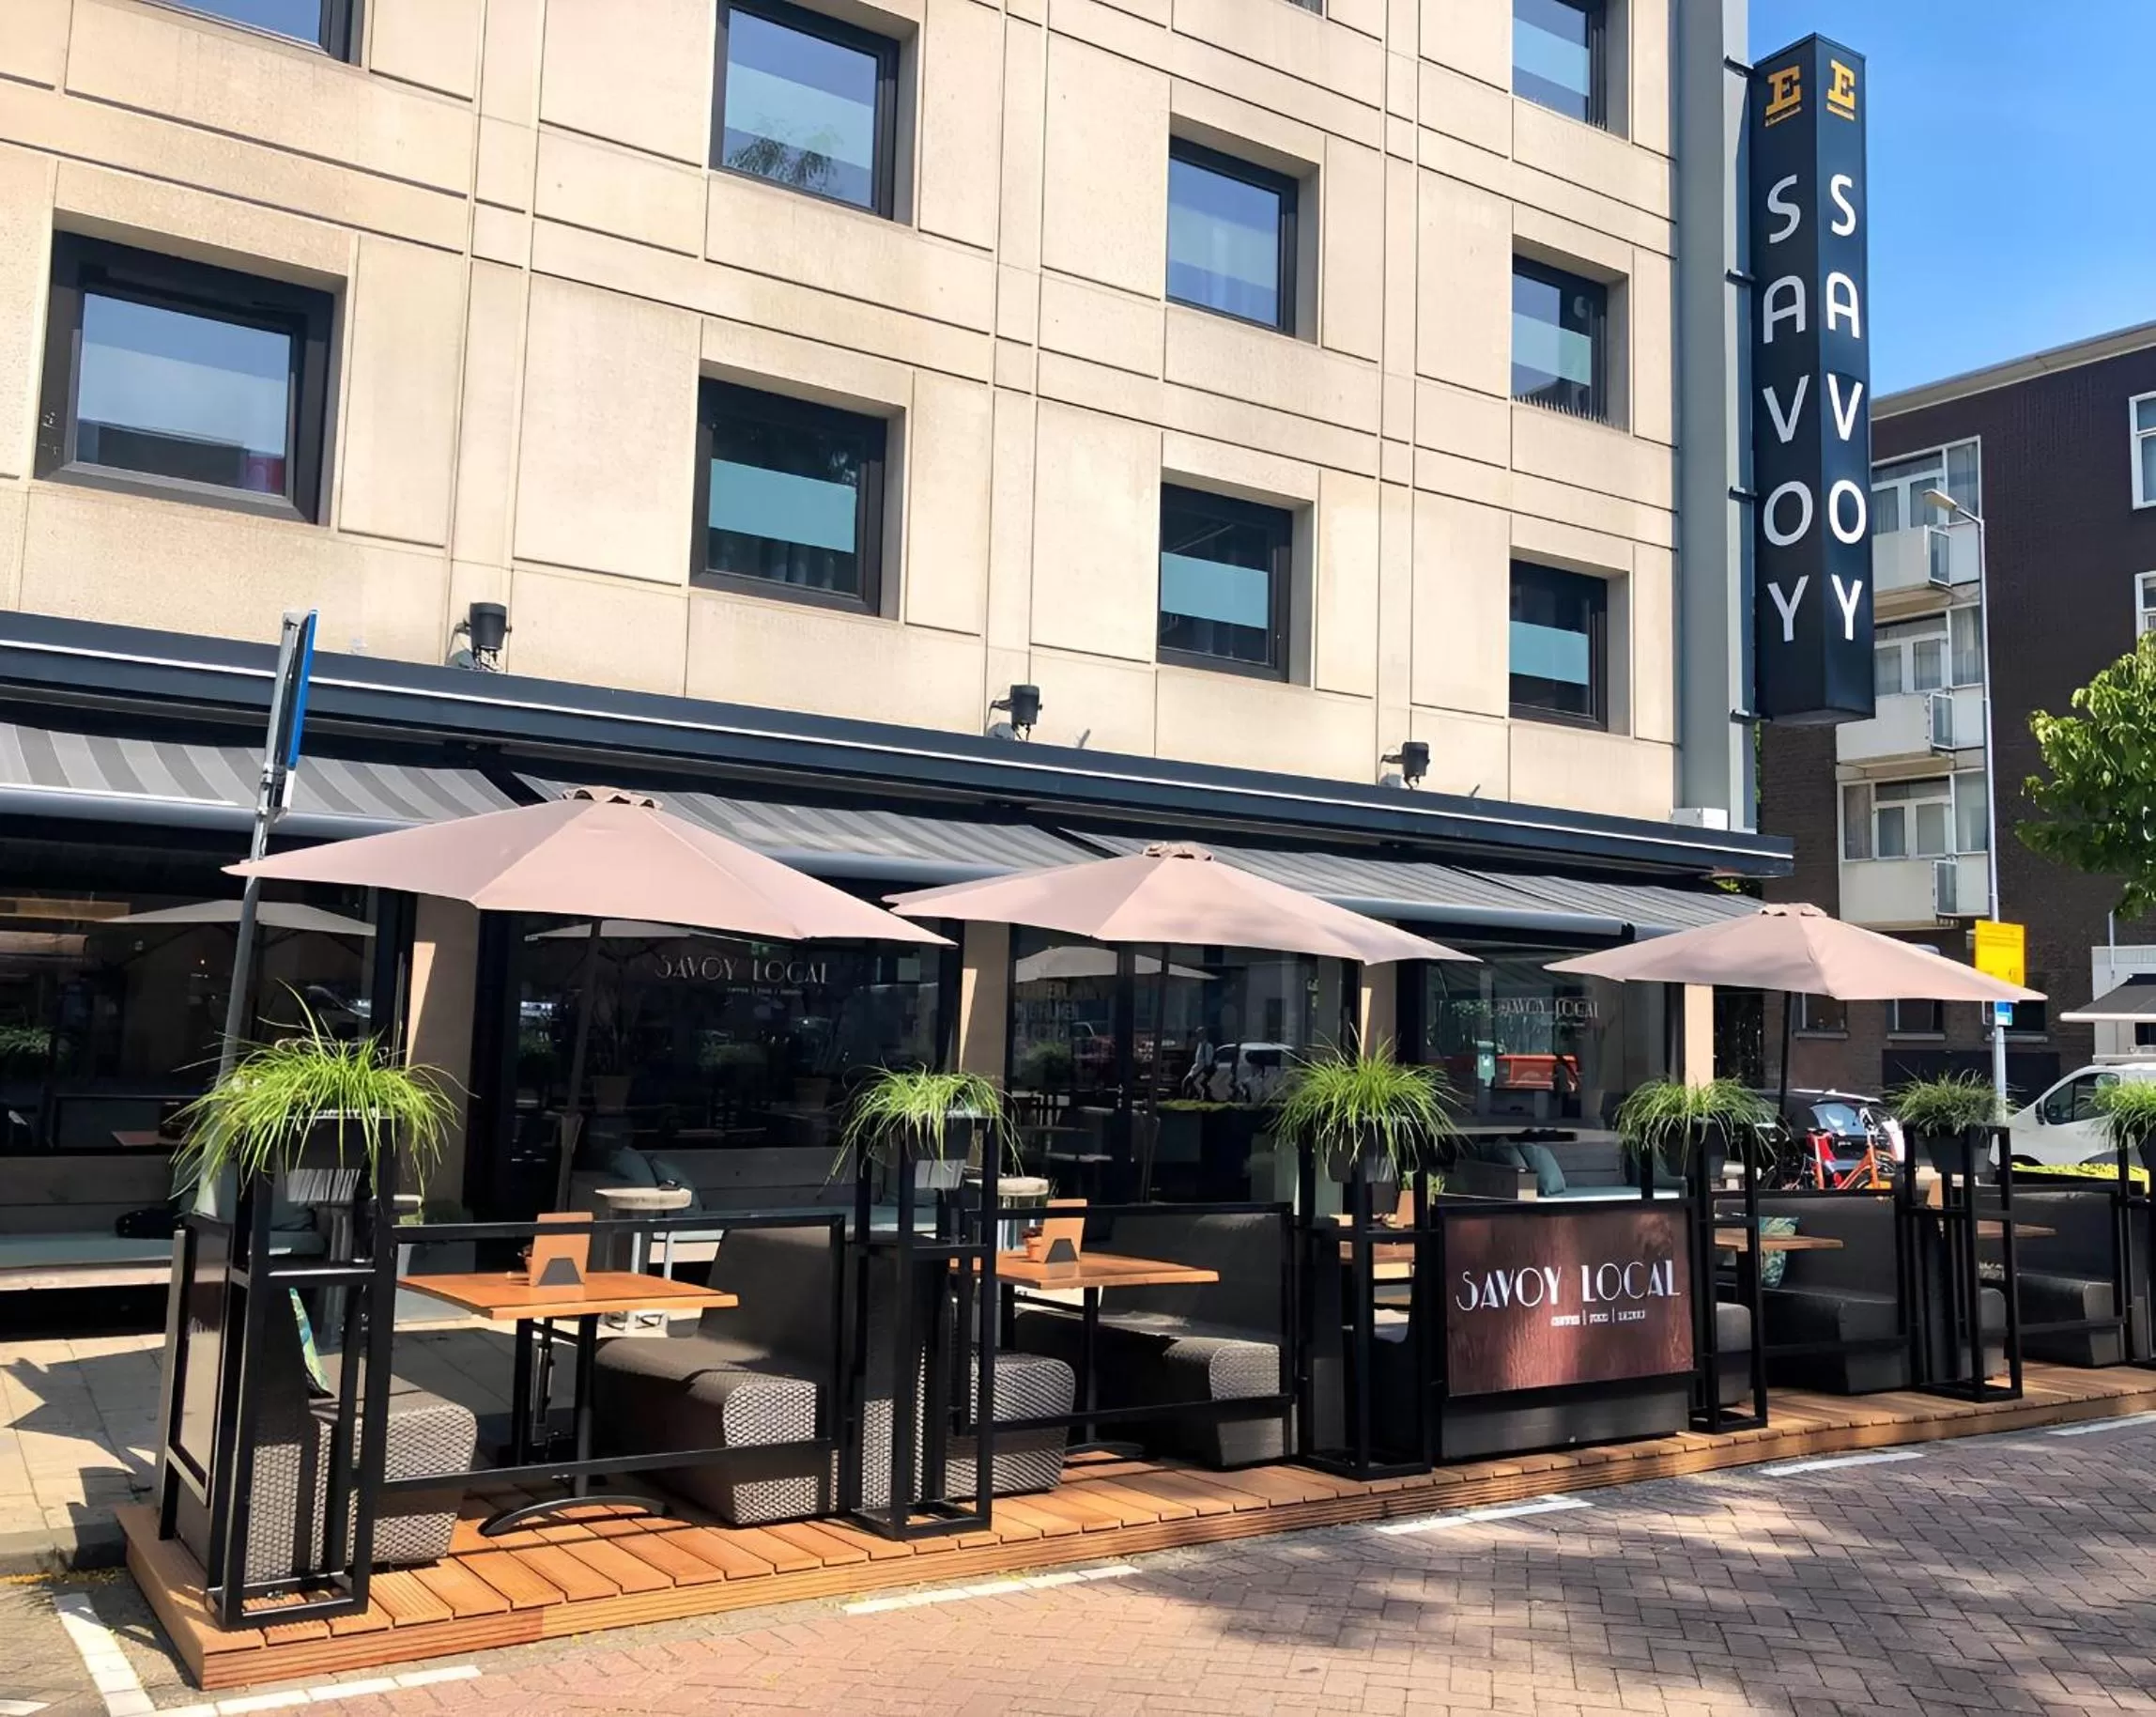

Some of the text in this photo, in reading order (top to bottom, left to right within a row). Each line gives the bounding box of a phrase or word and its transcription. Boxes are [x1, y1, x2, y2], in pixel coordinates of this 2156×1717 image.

[1762, 174, 1813, 642] SAVOY
[1826, 173, 1867, 642] SAVOY
[655, 954, 828, 984] SAVOY LOCAL
[1455, 1260, 1681, 1311] SAVOY LOCAL
